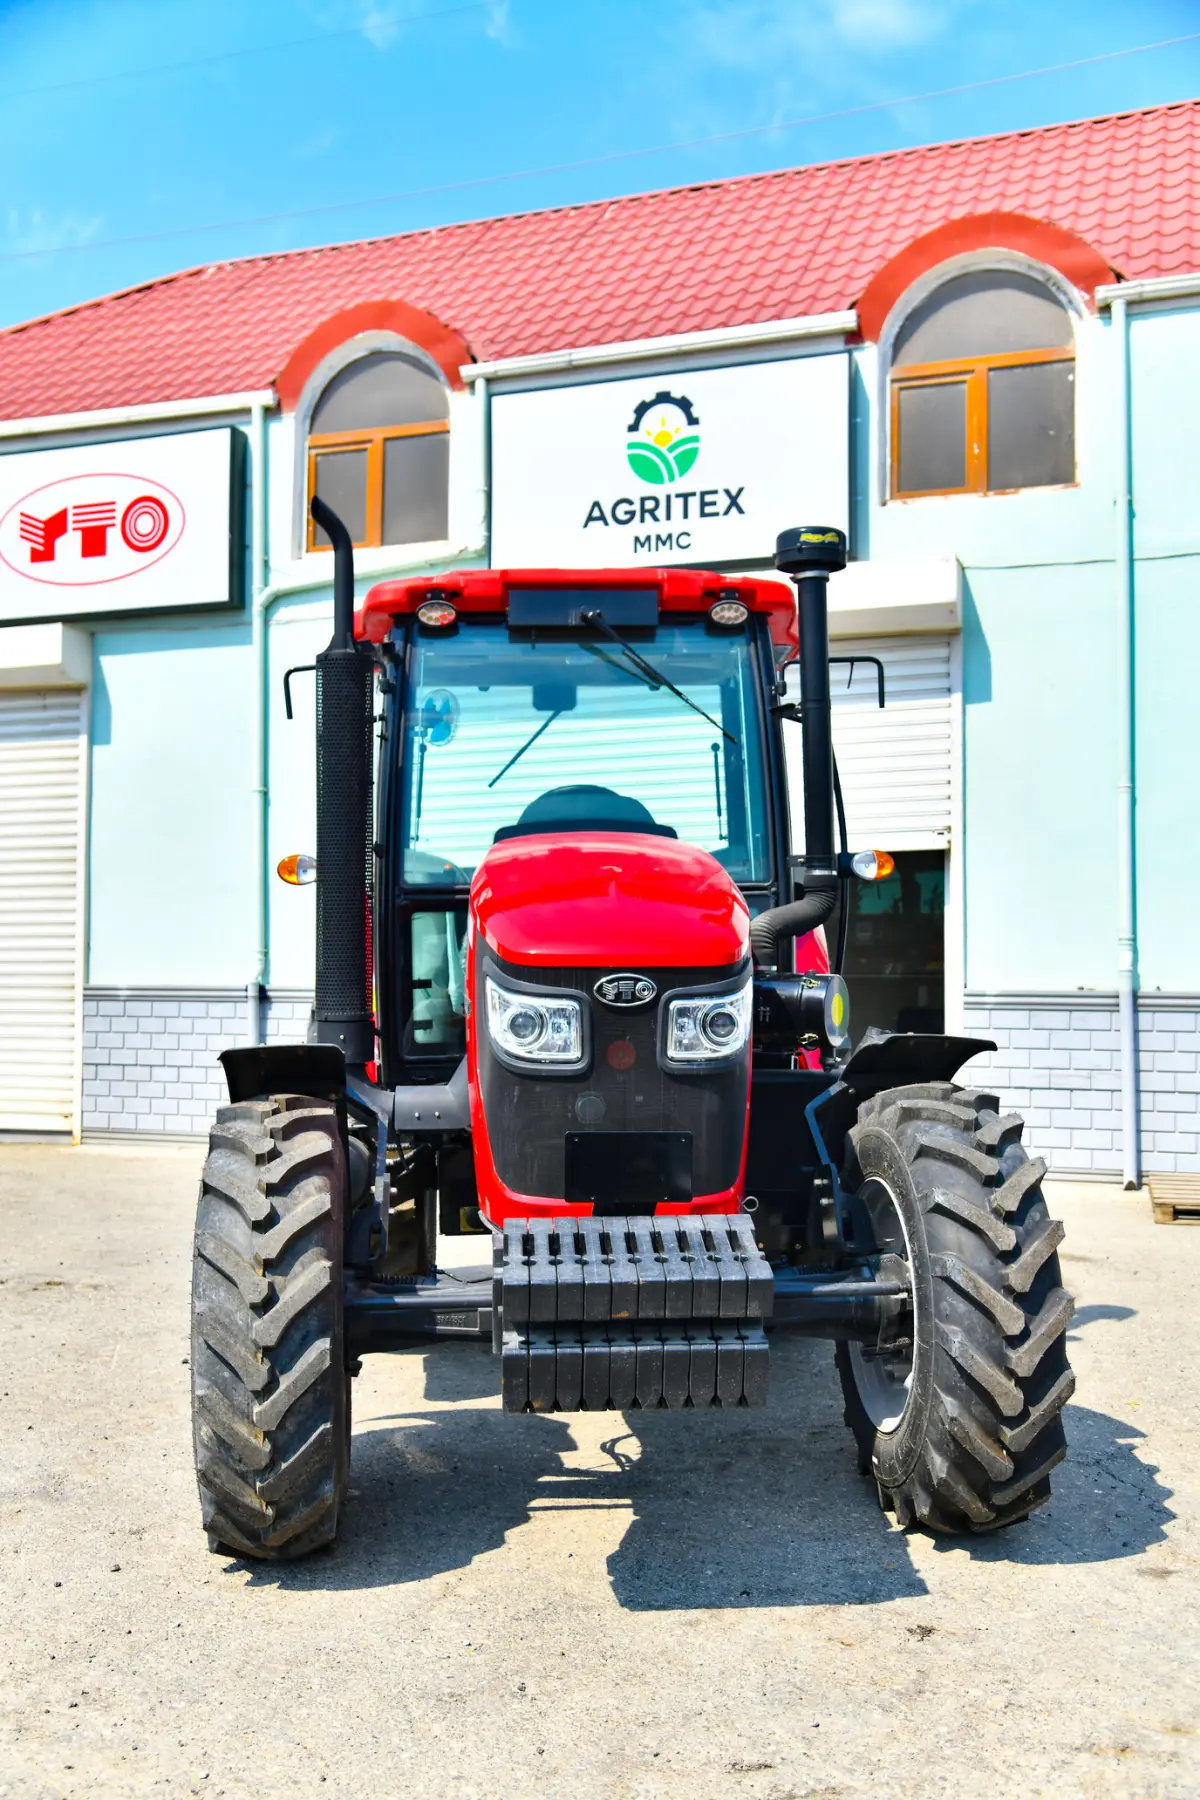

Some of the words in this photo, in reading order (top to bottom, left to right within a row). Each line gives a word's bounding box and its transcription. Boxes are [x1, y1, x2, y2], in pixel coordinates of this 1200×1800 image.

[583, 487, 745, 529] AGRITEX
[20, 495, 170, 563] YTO
[634, 531, 691, 554] MMC
[602, 980, 653, 1000] YTO
